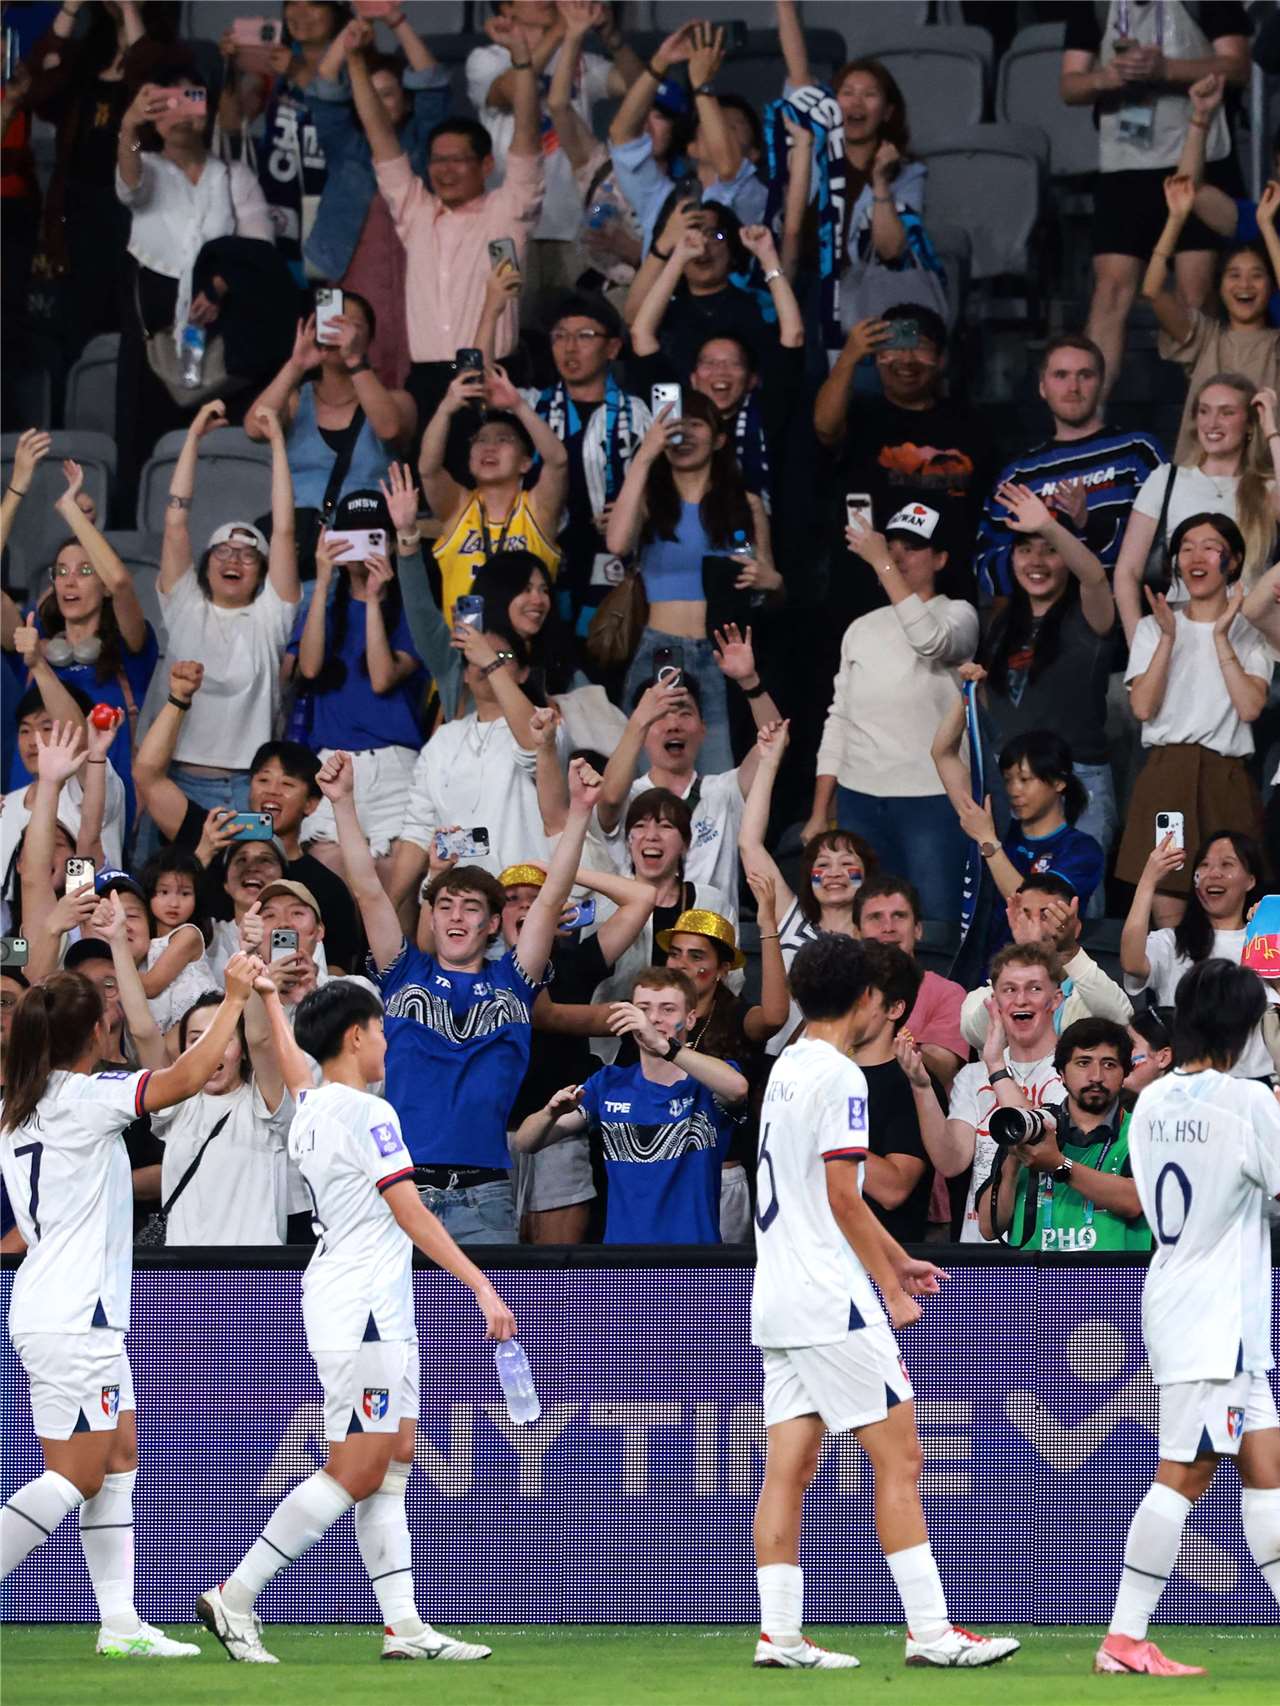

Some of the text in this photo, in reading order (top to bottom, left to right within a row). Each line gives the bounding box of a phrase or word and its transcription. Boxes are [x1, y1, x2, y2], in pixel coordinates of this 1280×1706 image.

[604, 1101, 631, 1113] TPE
[1175, 1120, 1210, 1143] HSU
[14, 1142, 43, 1241] 7
